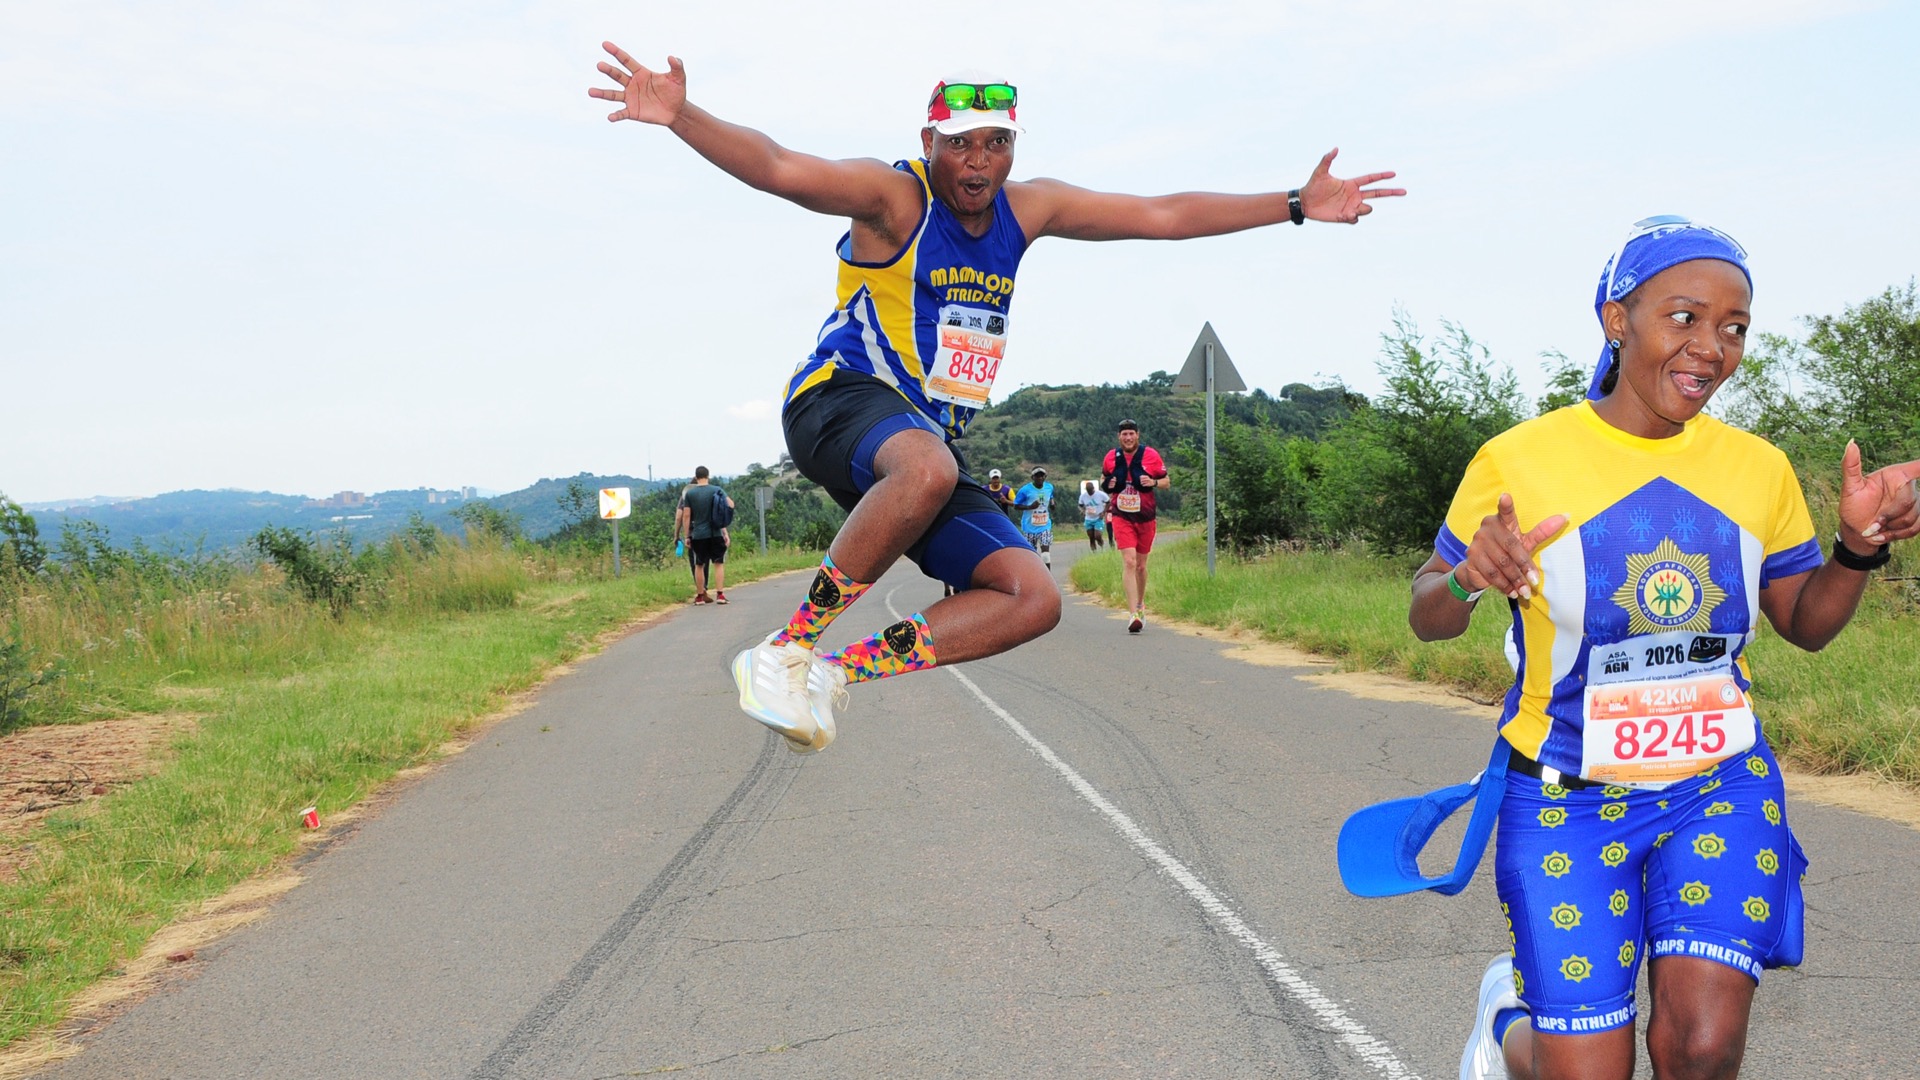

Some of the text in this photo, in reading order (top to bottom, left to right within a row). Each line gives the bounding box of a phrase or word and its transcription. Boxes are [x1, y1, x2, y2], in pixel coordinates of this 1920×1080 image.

[988, 317, 1003, 328] ASA
[967, 335, 993, 350] 42KM
[949, 351, 999, 385] 8434
[1638, 563, 1700, 590] SOUTH AFRICAN
[1640, 603, 1699, 625] POLICE SERVICE
[1607, 651, 1627, 660] ASA
[1645, 643, 1685, 667] 2026
[1692, 640, 1723, 651] ASA
[1604, 661, 1629, 674] AGN
[1640, 686, 1697, 706] 42KM
[1613, 713, 1726, 760] 8245
[1655, 939, 1685, 954] SAPS
[1688, 940, 1751, 970] ATHLETIC
[1537, 1015, 1567, 1031] SAPS
[1571, 1007, 1629, 1031] ATHLETIC
